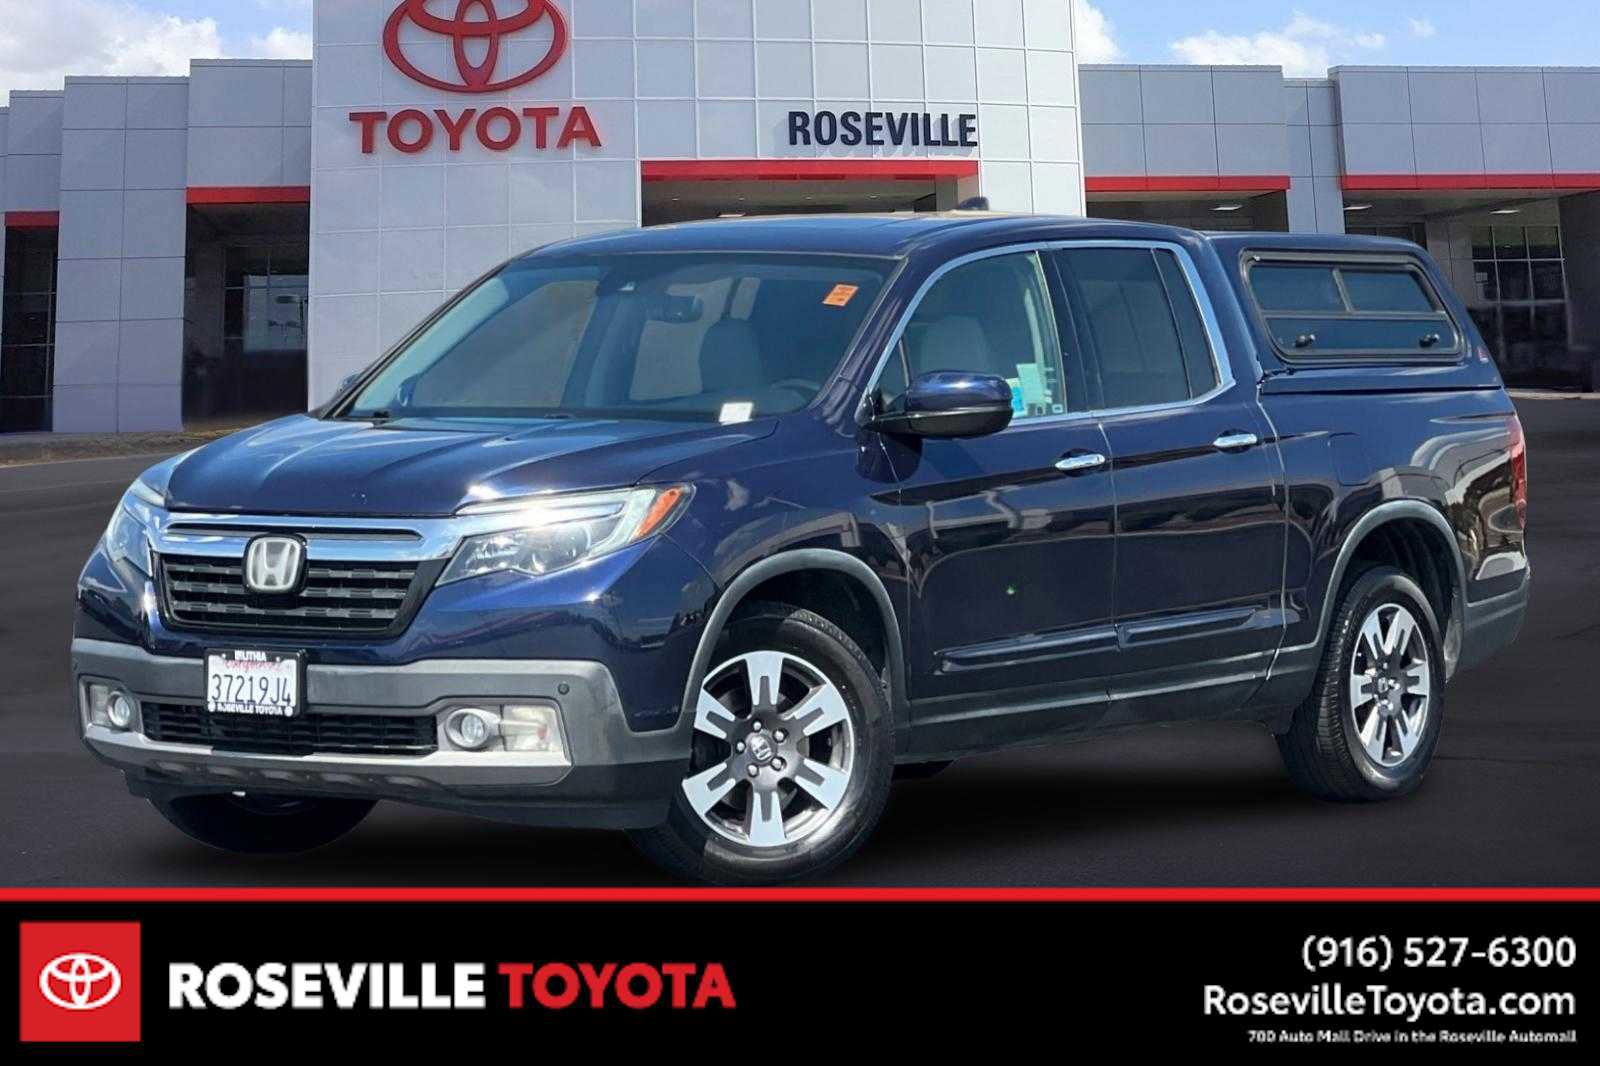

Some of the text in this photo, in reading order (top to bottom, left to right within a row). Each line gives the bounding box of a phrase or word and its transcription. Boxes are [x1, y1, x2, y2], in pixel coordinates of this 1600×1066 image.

[349, 106, 602, 154] TOYOTA
[788, 111, 979, 147] ROSEVILLE
[211, 673, 292, 705] 37219J4
